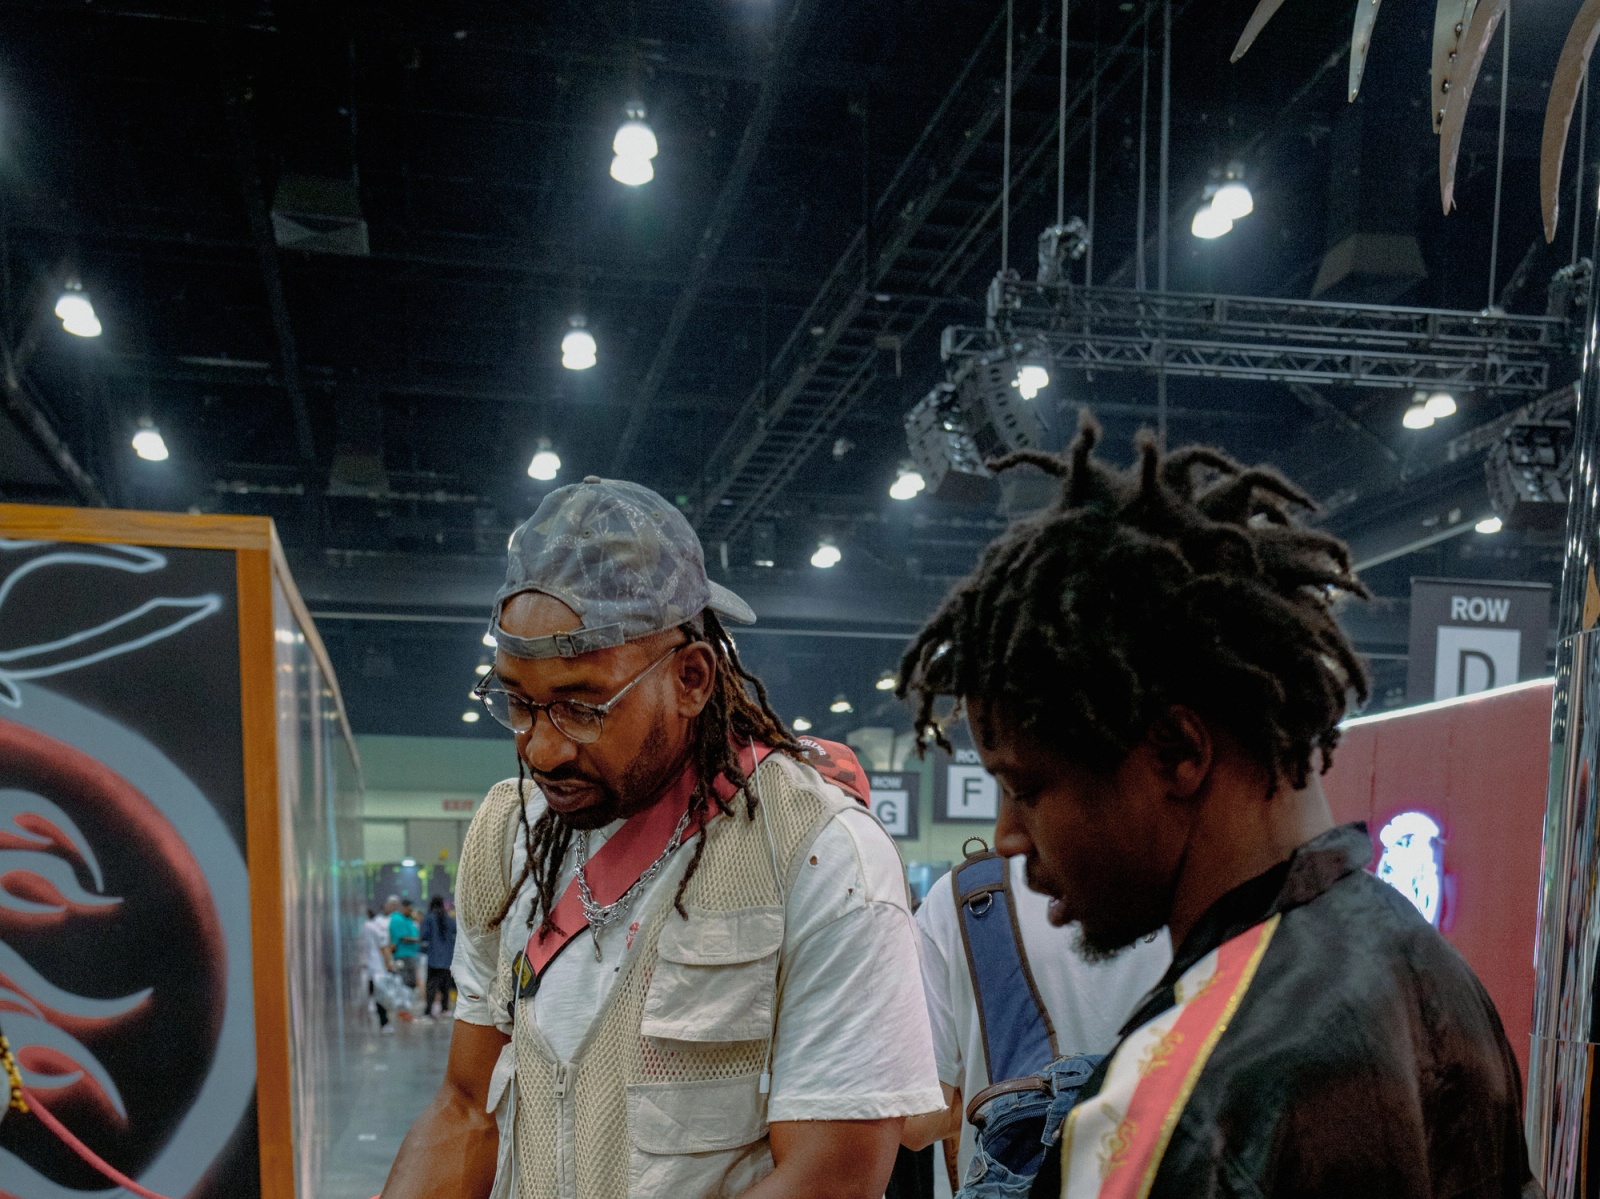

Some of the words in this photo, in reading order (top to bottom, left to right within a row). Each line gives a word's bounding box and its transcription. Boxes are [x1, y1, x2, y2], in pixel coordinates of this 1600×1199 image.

[1451, 595, 1510, 622] ROW
[1458, 649, 1496, 696] D
[871, 776, 902, 789] ROW
[963, 777, 982, 807] F
[876, 799, 897, 825] G
